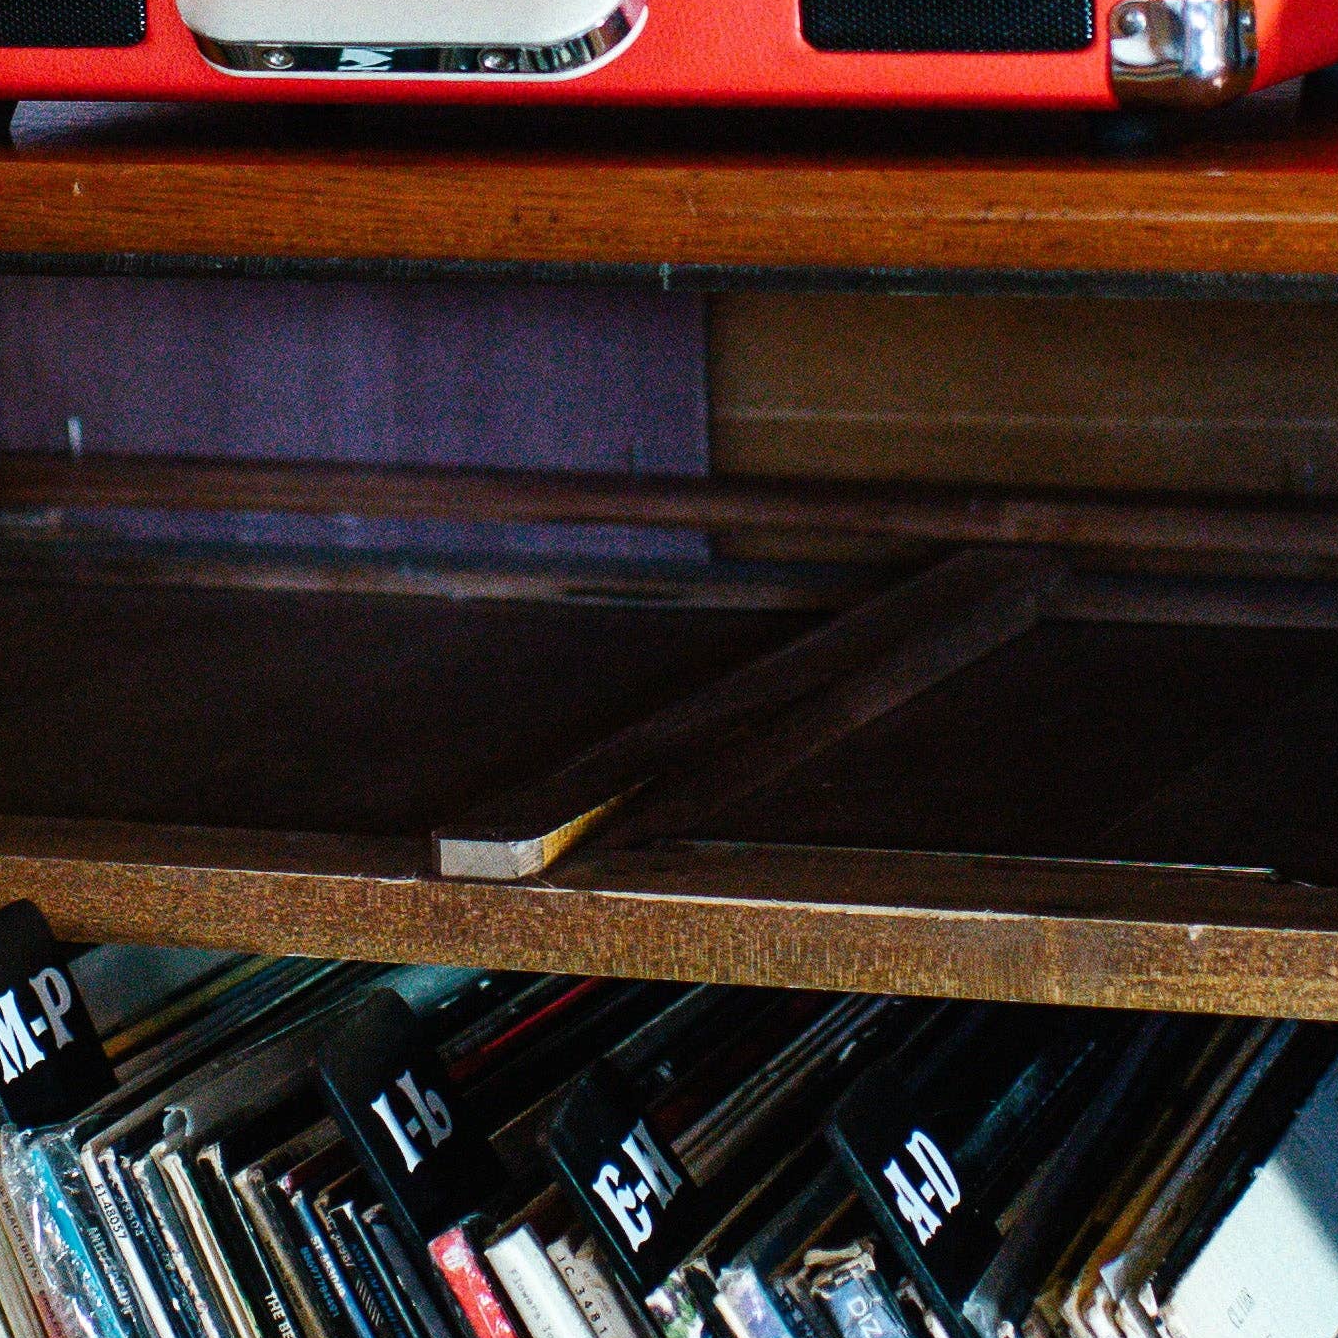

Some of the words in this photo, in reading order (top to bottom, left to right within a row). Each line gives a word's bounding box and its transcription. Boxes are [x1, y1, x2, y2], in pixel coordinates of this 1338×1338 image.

[591, 1117, 683, 1253] E-H
[883, 1129, 962, 1246] A-D
[19, 1243, 41, 1279] BOYS
[260, 1289, 286, 1323] THE
[508, 1266, 545, 1320] Flowers
